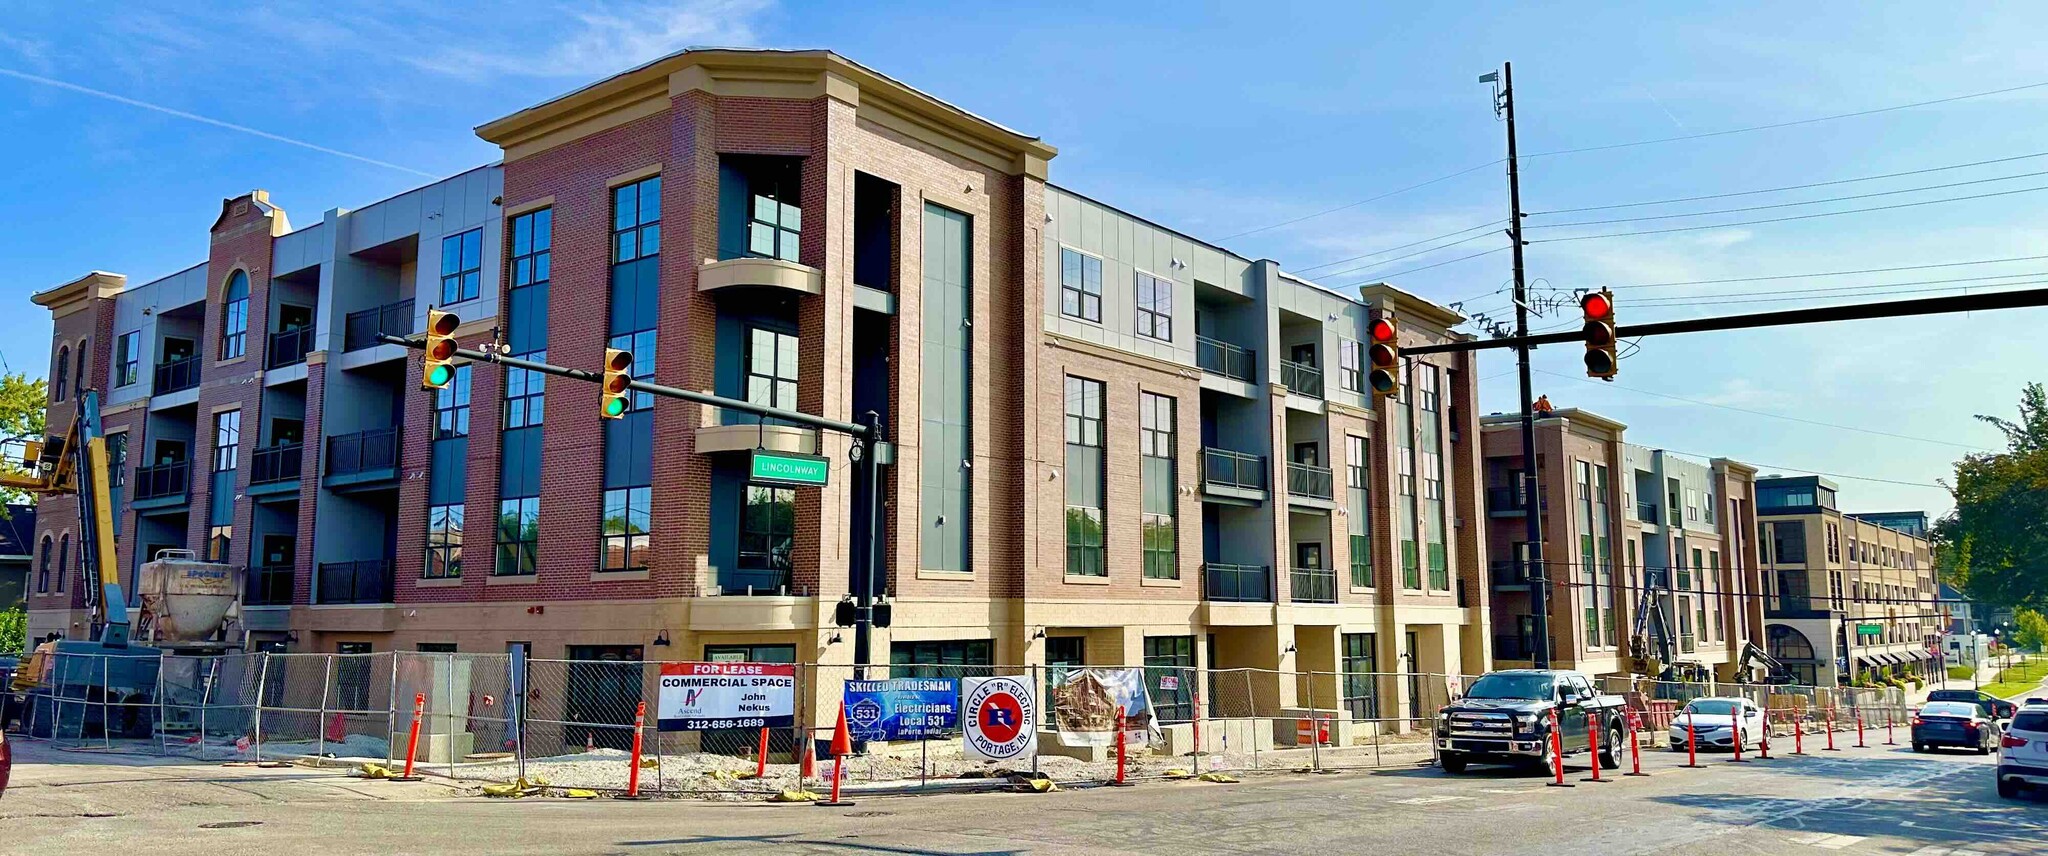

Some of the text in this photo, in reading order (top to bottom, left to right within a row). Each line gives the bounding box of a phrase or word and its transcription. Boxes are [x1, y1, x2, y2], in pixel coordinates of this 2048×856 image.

[761, 462, 819, 475] LINCOLNWAY
[694, 665, 763, 675] FOR LEASE
[662, 678, 792, 687] COMMERCIAL SPACE
[849, 680, 951, 692] SKILLED TRADESMAN
[741, 693, 766, 701] John
[738, 704, 770, 712] Nekus
[894, 703, 952, 713] Electricians
[968, 682, 1031, 727] CIRCLE "R" ELECTRIC
[856, 709, 876, 719] 531
[687, 719, 765, 729] 312-656-1689
[900, 715, 945, 726] Local 531
[975, 733, 1027, 755] PORTAGE, IN
